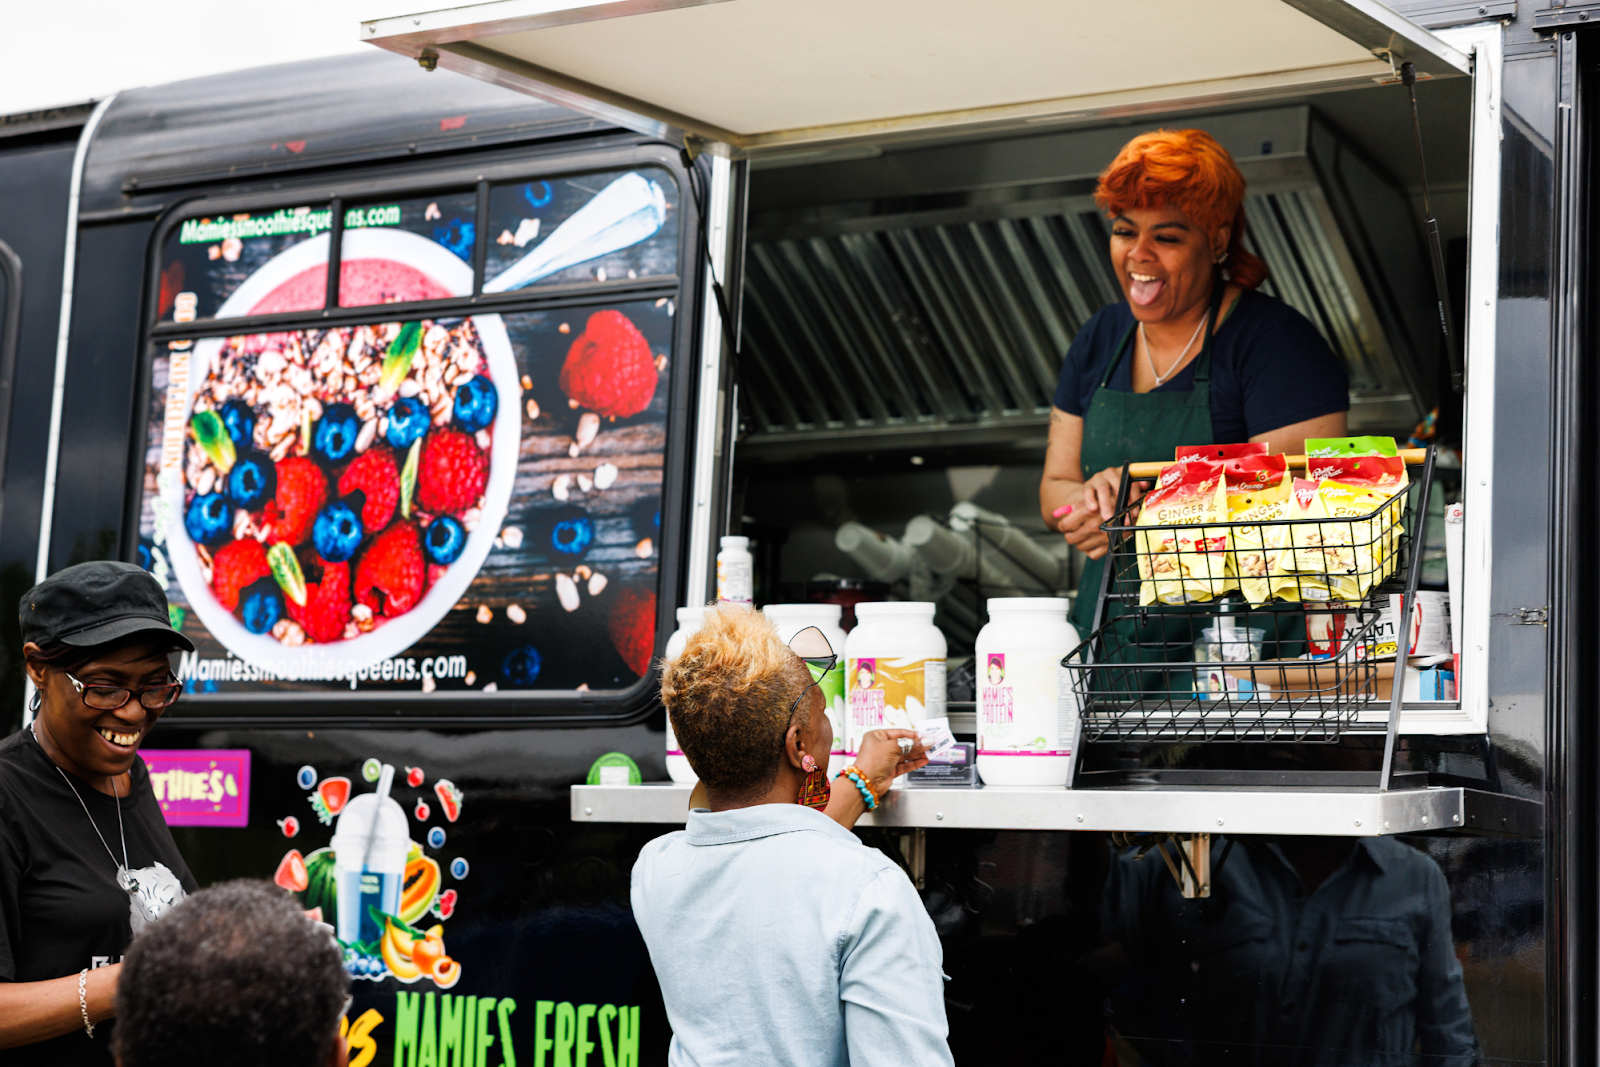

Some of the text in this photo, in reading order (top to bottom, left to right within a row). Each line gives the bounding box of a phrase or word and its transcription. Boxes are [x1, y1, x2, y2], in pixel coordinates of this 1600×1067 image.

[180, 205, 401, 243] Mamiessmoothiesquens.com
[1157, 503, 1204, 521] GINGER
[178, 649, 468, 690] Mamiessmoothiesqueens.com
[982, 704, 1014, 723] PROTEIN
[393, 990, 517, 1067] MAMIES
[533, 1000, 640, 1067] FRESH
